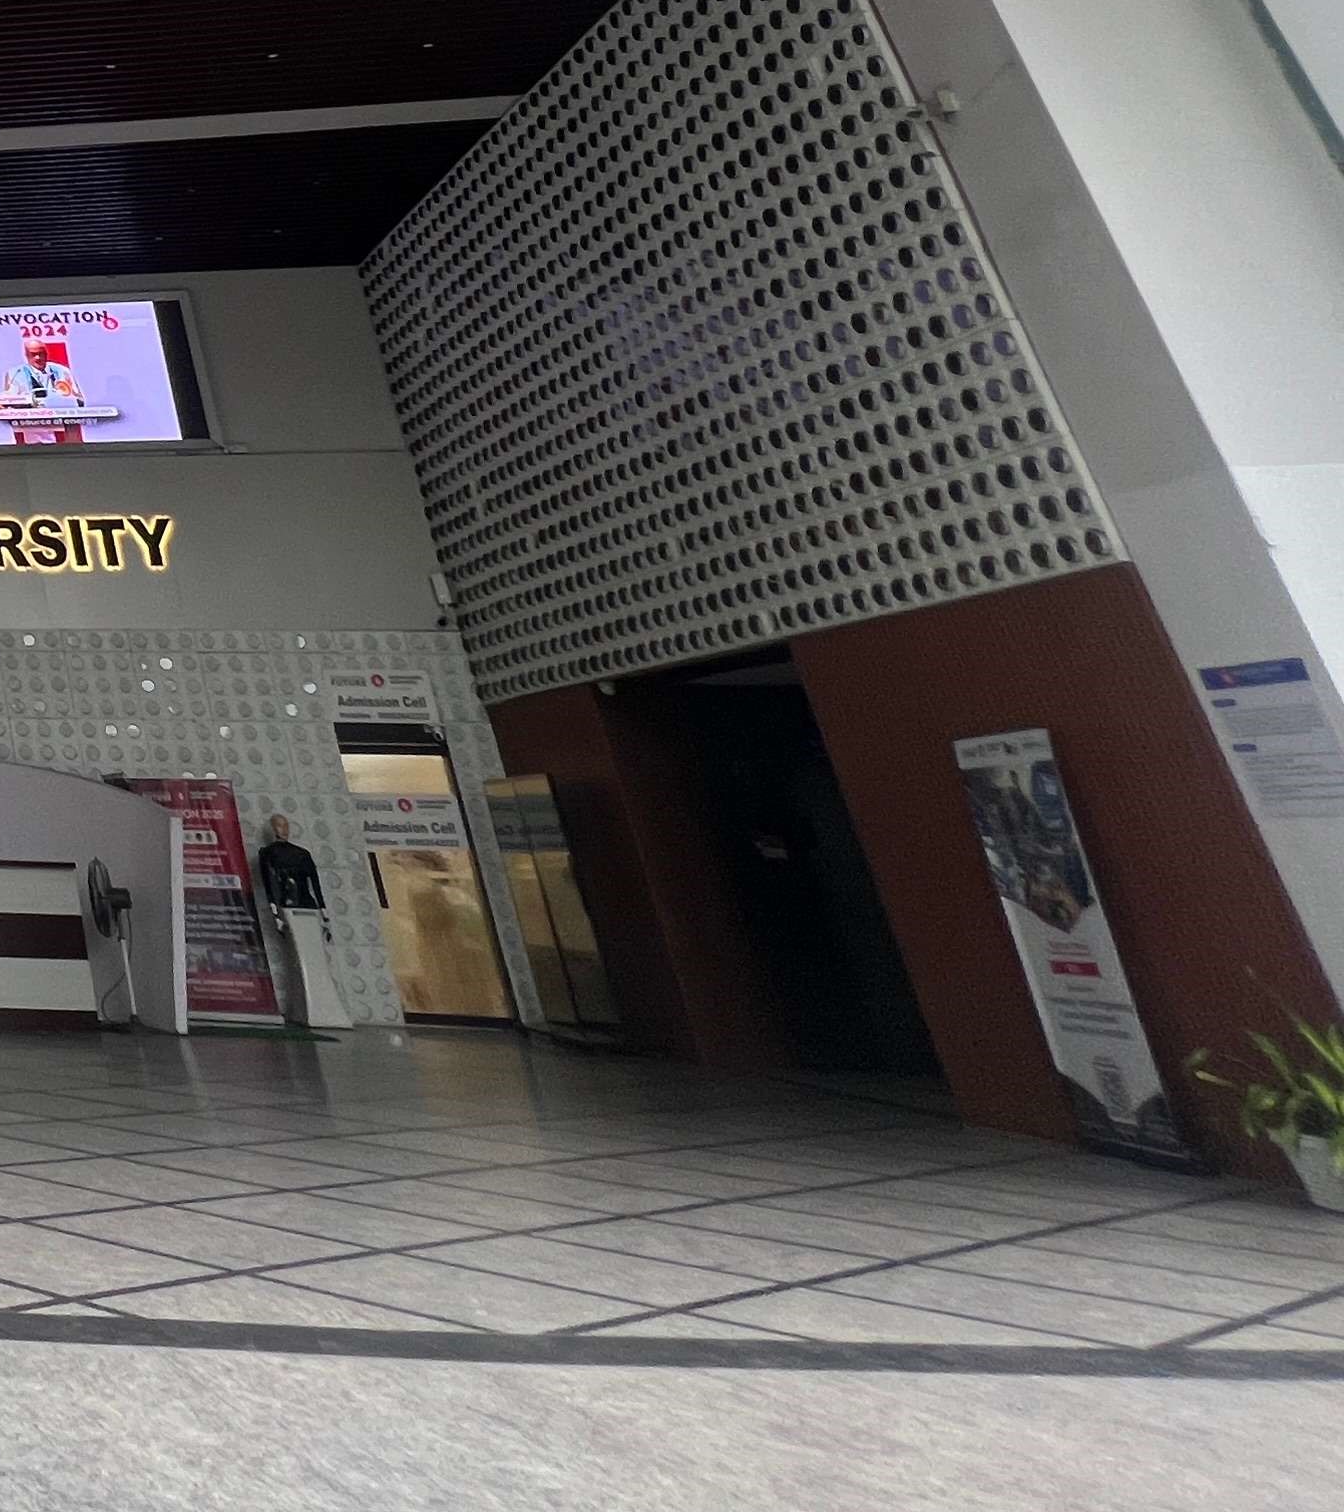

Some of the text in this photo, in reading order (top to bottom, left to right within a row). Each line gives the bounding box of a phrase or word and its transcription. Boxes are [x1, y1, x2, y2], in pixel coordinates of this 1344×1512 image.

[19, 324, 68, 338] 2024
[337, 694, 427, 708] Admission Cell
[363, 820, 457, 834] Admission Cell
